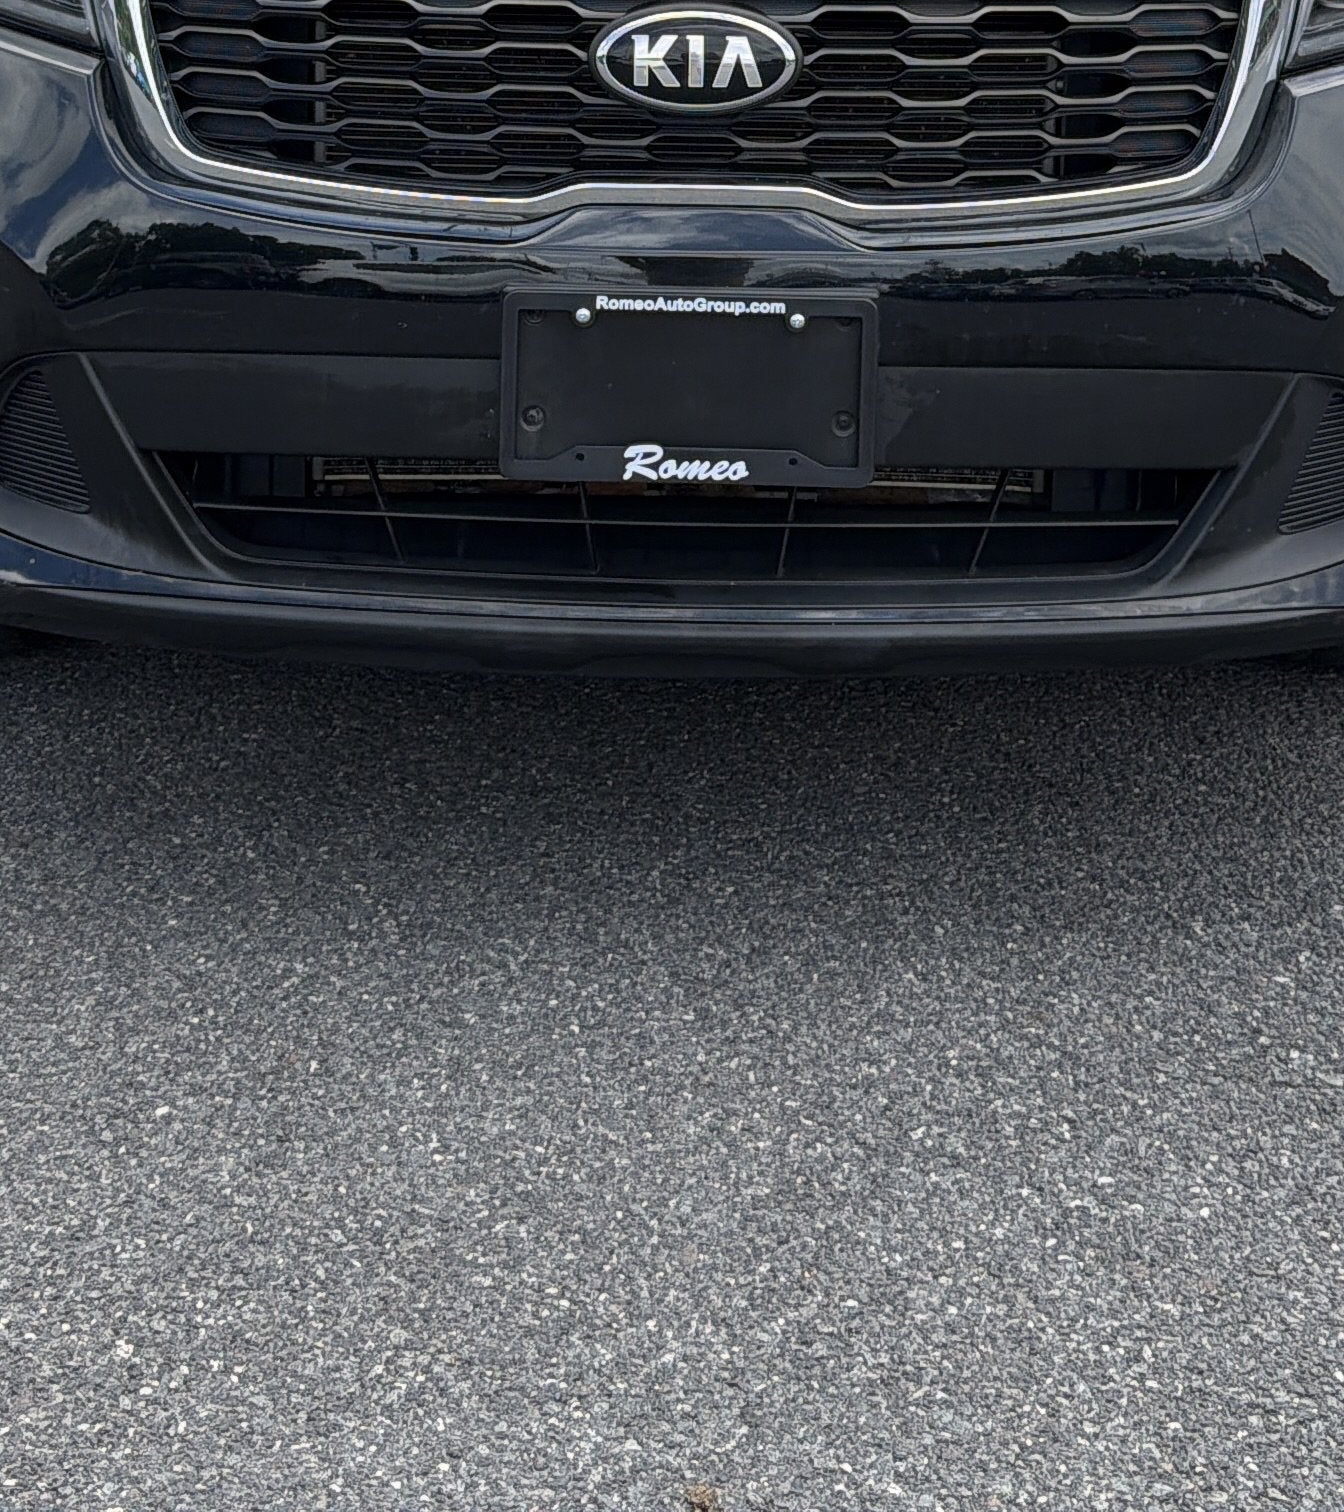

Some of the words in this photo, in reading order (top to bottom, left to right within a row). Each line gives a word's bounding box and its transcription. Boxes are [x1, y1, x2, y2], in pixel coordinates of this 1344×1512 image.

[631, 35, 763, 88] KIA
[595, 295, 786, 317] RomeoAutoGroup.com
[622, 444, 750, 482] Romeo
